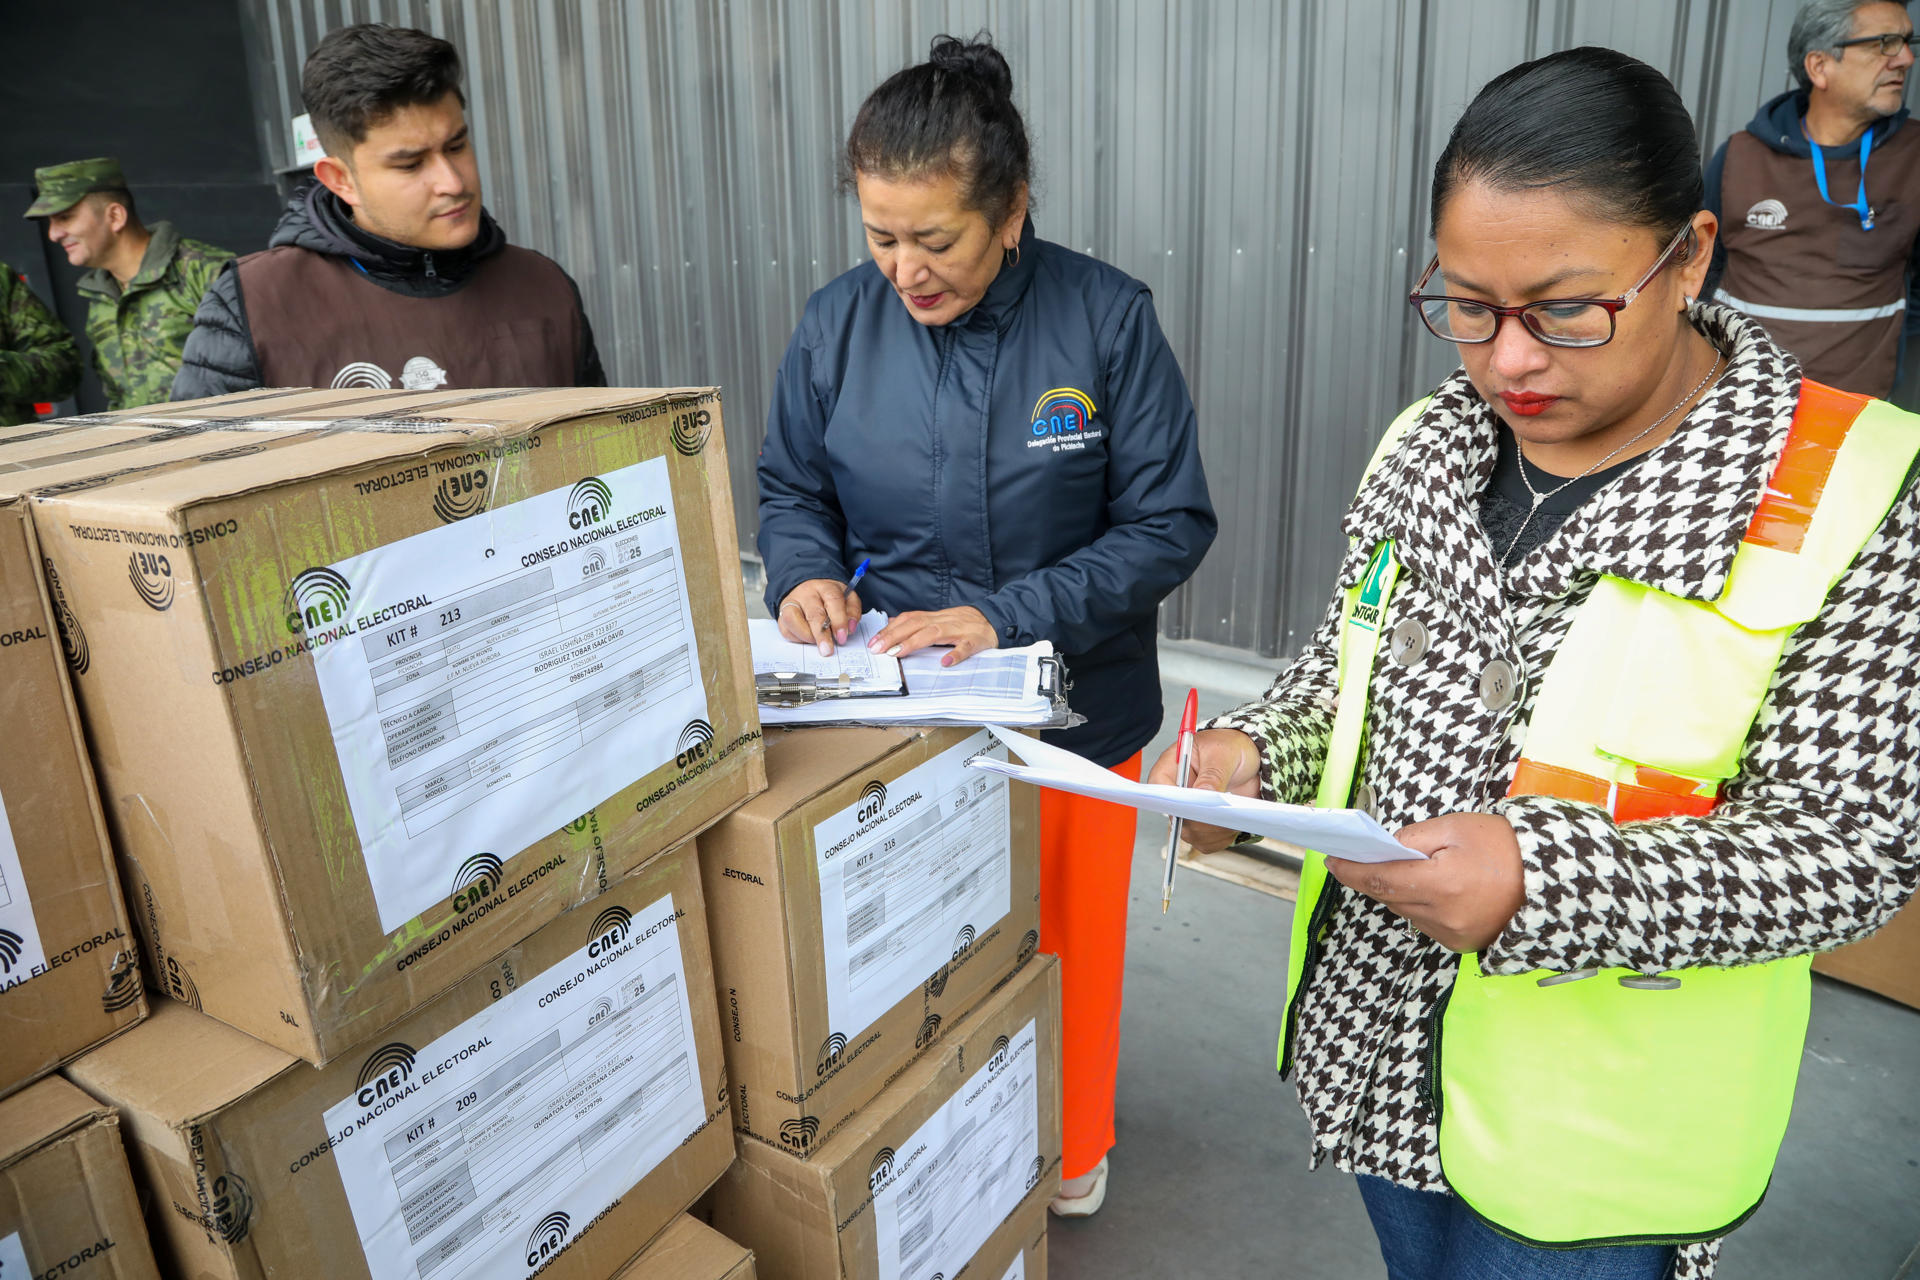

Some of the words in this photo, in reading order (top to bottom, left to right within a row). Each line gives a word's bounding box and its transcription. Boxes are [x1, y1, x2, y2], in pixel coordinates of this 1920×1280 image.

[616, 402, 667, 425] ELECTORAL
[354, 467, 429, 496] ELECTORAL
[430, 451, 490, 474] NACIONAL
[69, 524, 121, 543] ELECTORAL
[120, 530, 169, 548] NACIONAL
[170, 518, 238, 549] CONSEJO
[521, 541, 569, 568] CONSEJO
[569, 524, 617, 549] NACIONAL
[617, 505, 666, 531] ELECTORAL
[212, 650, 282, 685] CONSEJO
[285, 623, 356, 660] NACIONAL
[357, 594, 432, 631] ELECTORAL
[386, 629, 407, 647] KIT
[440, 608, 461, 626] 213
[534, 654, 570, 674] RODRIGUEZ
[571, 645, 592, 658] TOBAR
[607, 629, 624, 643] DAVID
[538, 648, 559, 660] ISRAEL
[636, 781, 676, 812] CONSEJO
[676, 756, 718, 786] NACIONAL
[718, 729, 762, 760] ELECTORAL
[825, 834, 855, 859] CONSEJO
[855, 814, 888, 838] NACIONAL
[888, 791, 922, 818] ELECTORAL
[722, 868, 764, 886] ECTORAL
[856, 855, 868, 868] KIT
[396, 928, 451, 971] CONSEJO
[452, 894, 507, 935] NACIONAL
[507, 854, 566, 898] ELECTORAL
[30, 927, 126, 978] ELECTORAL
[538, 972, 585, 1009] CONSEJO
[587, 942, 634, 977] NACIONAL
[635, 908, 686, 945] ELECTORAL
[730, 997, 741, 1043] CONSEJO
[585, 1074, 608, 1092] TATIANA
[608, 1055, 634, 1076] CAROLINA
[776, 1088, 814, 1105] CONSEJO
[814, 1061, 846, 1090] NACIONAL
[847, 1032, 882, 1063] ELECTORAL
[965, 1082, 987, 1106] CONSEJO
[987, 1061, 1010, 1083] NACIONAL
[1010, 1036, 1034, 1062] ELECTORAL
[290, 1126, 353, 1174] CONSEJO
[356, 1083, 421, 1130] NACIONAL
[422, 1036, 492, 1085] ELECTORAL
[406, 1123, 425, 1143] KIT
[455, 1091, 477, 1111] 209
[682, 1113, 715, 1146] CONSEJO
[837, 1202, 866, 1233] CONSEJO
[866, 1174, 897, 1205] NACIONAL
[897, 1143, 927, 1177] ELECTORAL
[525, 1243, 571, 1280] NACIONAL
[572, 1198, 622, 1244] ELECTORAL
